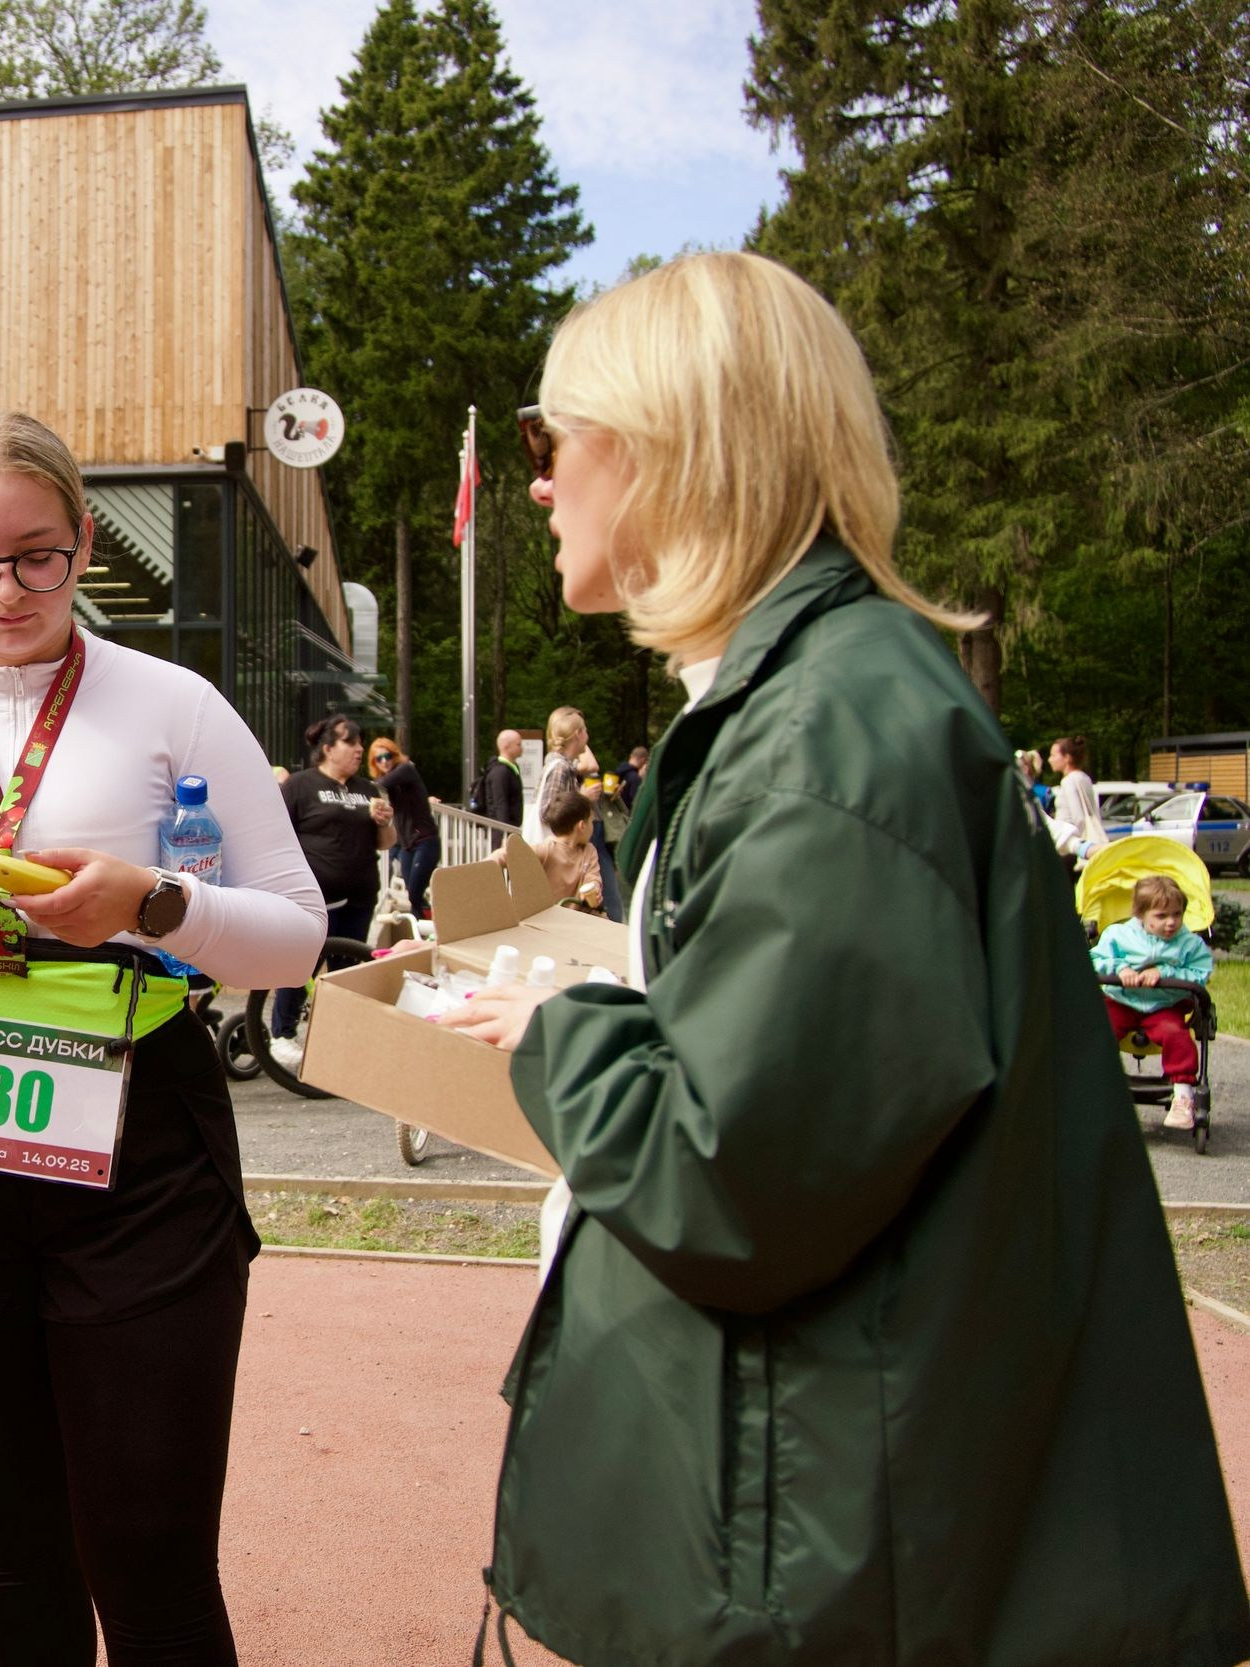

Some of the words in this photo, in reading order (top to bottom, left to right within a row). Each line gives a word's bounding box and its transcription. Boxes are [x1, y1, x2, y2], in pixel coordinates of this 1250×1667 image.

[43, 652, 82, 731] АПРЕЛЕВКА
[178, 855, 217, 875] Arctic
[26, 1034, 106, 1062] ДУБКИ
[21, 1150, 90, 1173] 14.09.25
